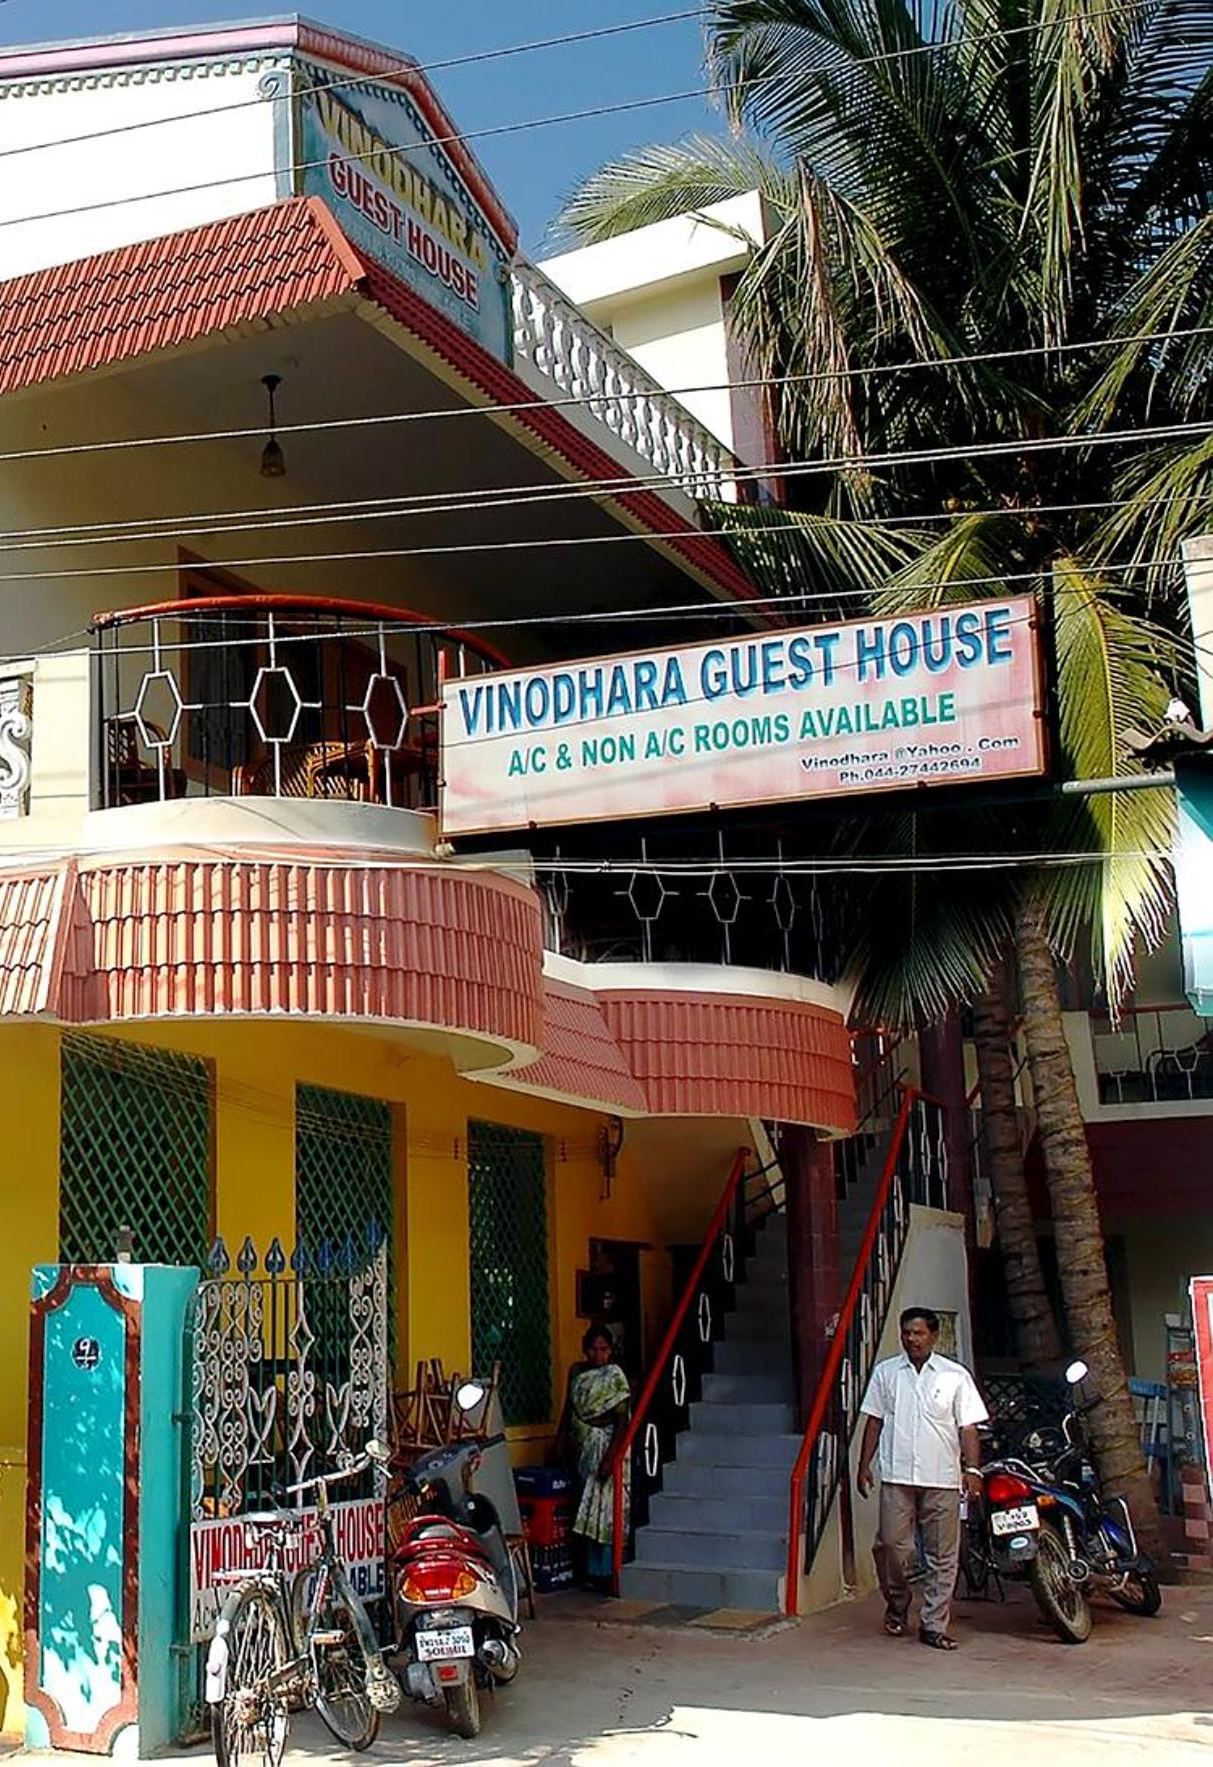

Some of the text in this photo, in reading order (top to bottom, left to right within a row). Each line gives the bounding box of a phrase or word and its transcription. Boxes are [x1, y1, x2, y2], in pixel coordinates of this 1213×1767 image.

[329, 151, 404, 244] GUEST
[406, 216, 481, 313] HOUSE
[458, 608, 1013, 737] VINODHARA GUEST HOUSE
[508, 692, 956, 777] A/C & NON A/C ROOMS AVAILABLE
[801, 751, 889, 770] Vinodhara
[338, 1502, 384, 1562] HOUSE
